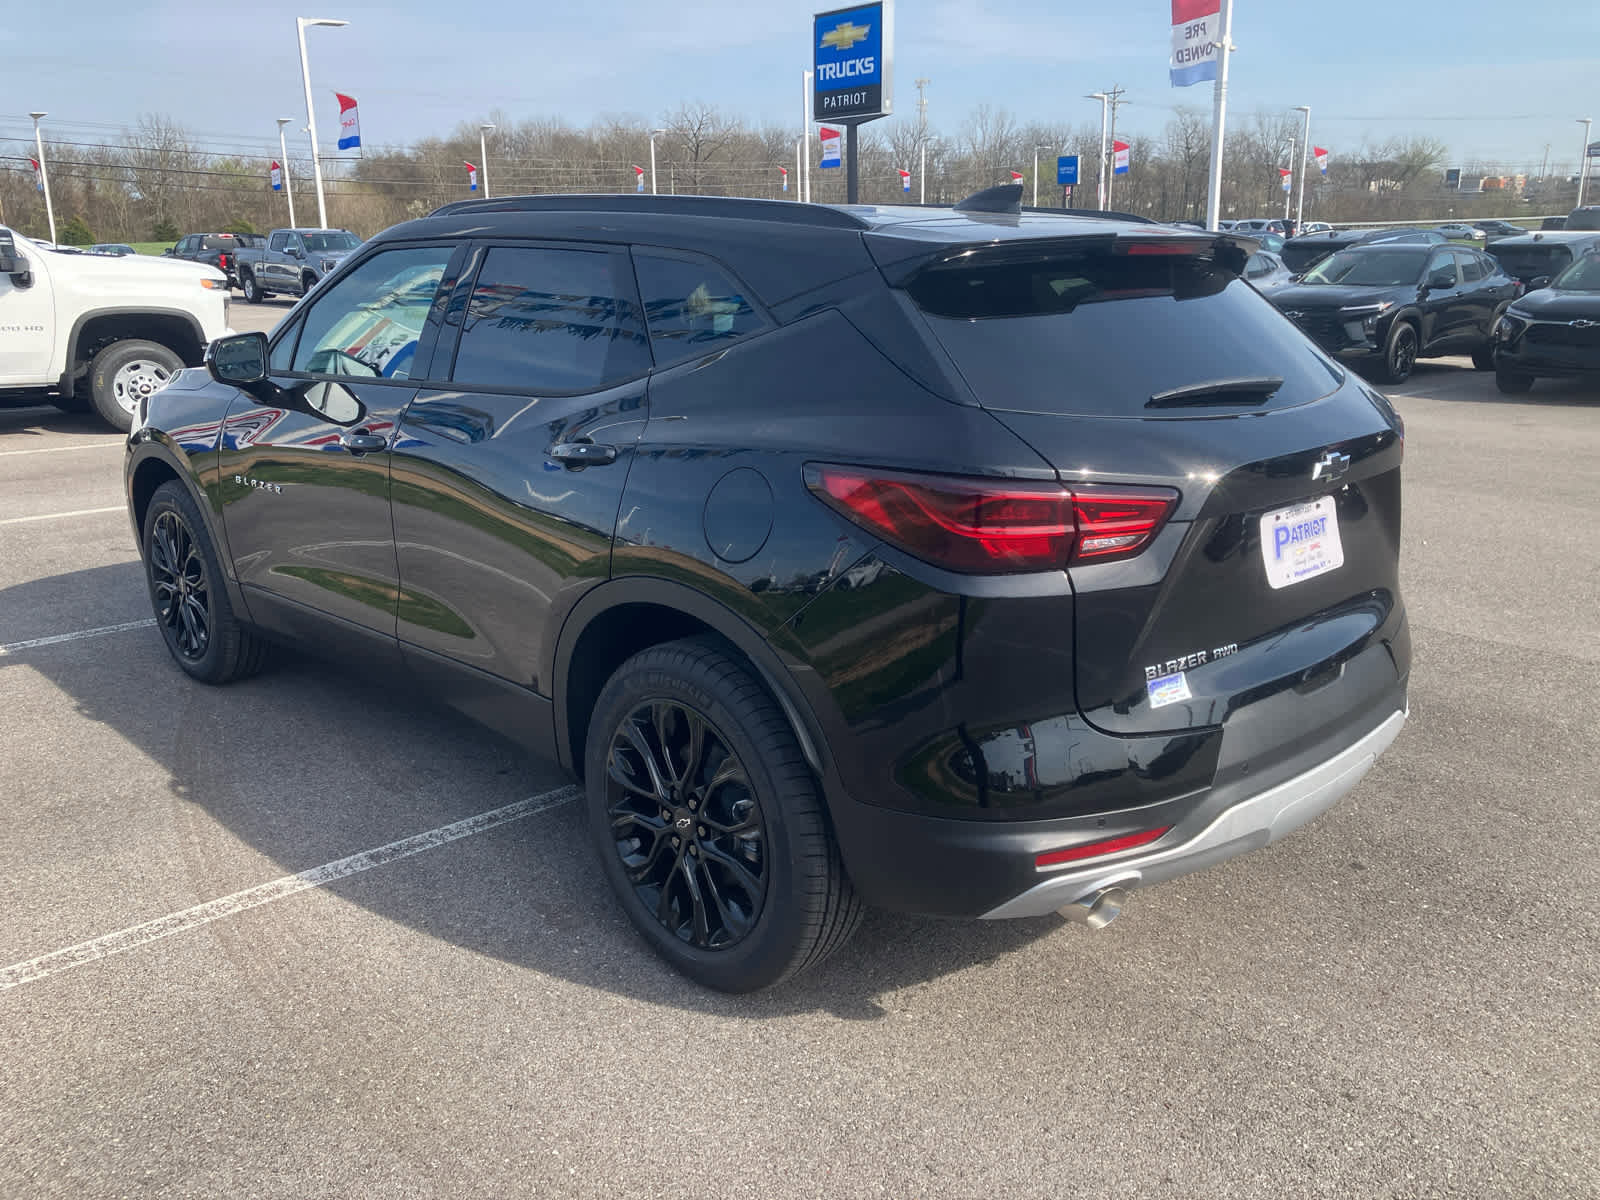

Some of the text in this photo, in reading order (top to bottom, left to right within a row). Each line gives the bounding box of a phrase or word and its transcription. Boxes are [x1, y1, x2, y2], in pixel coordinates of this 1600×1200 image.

[817, 56, 875, 81] TRUCKS
[824, 91, 867, 109] PATRIOT
[235, 475, 281, 495] BLAZER
[1273, 516, 1327, 560] PATRIOT
[1144, 643, 1239, 681] BLAZER AWD
